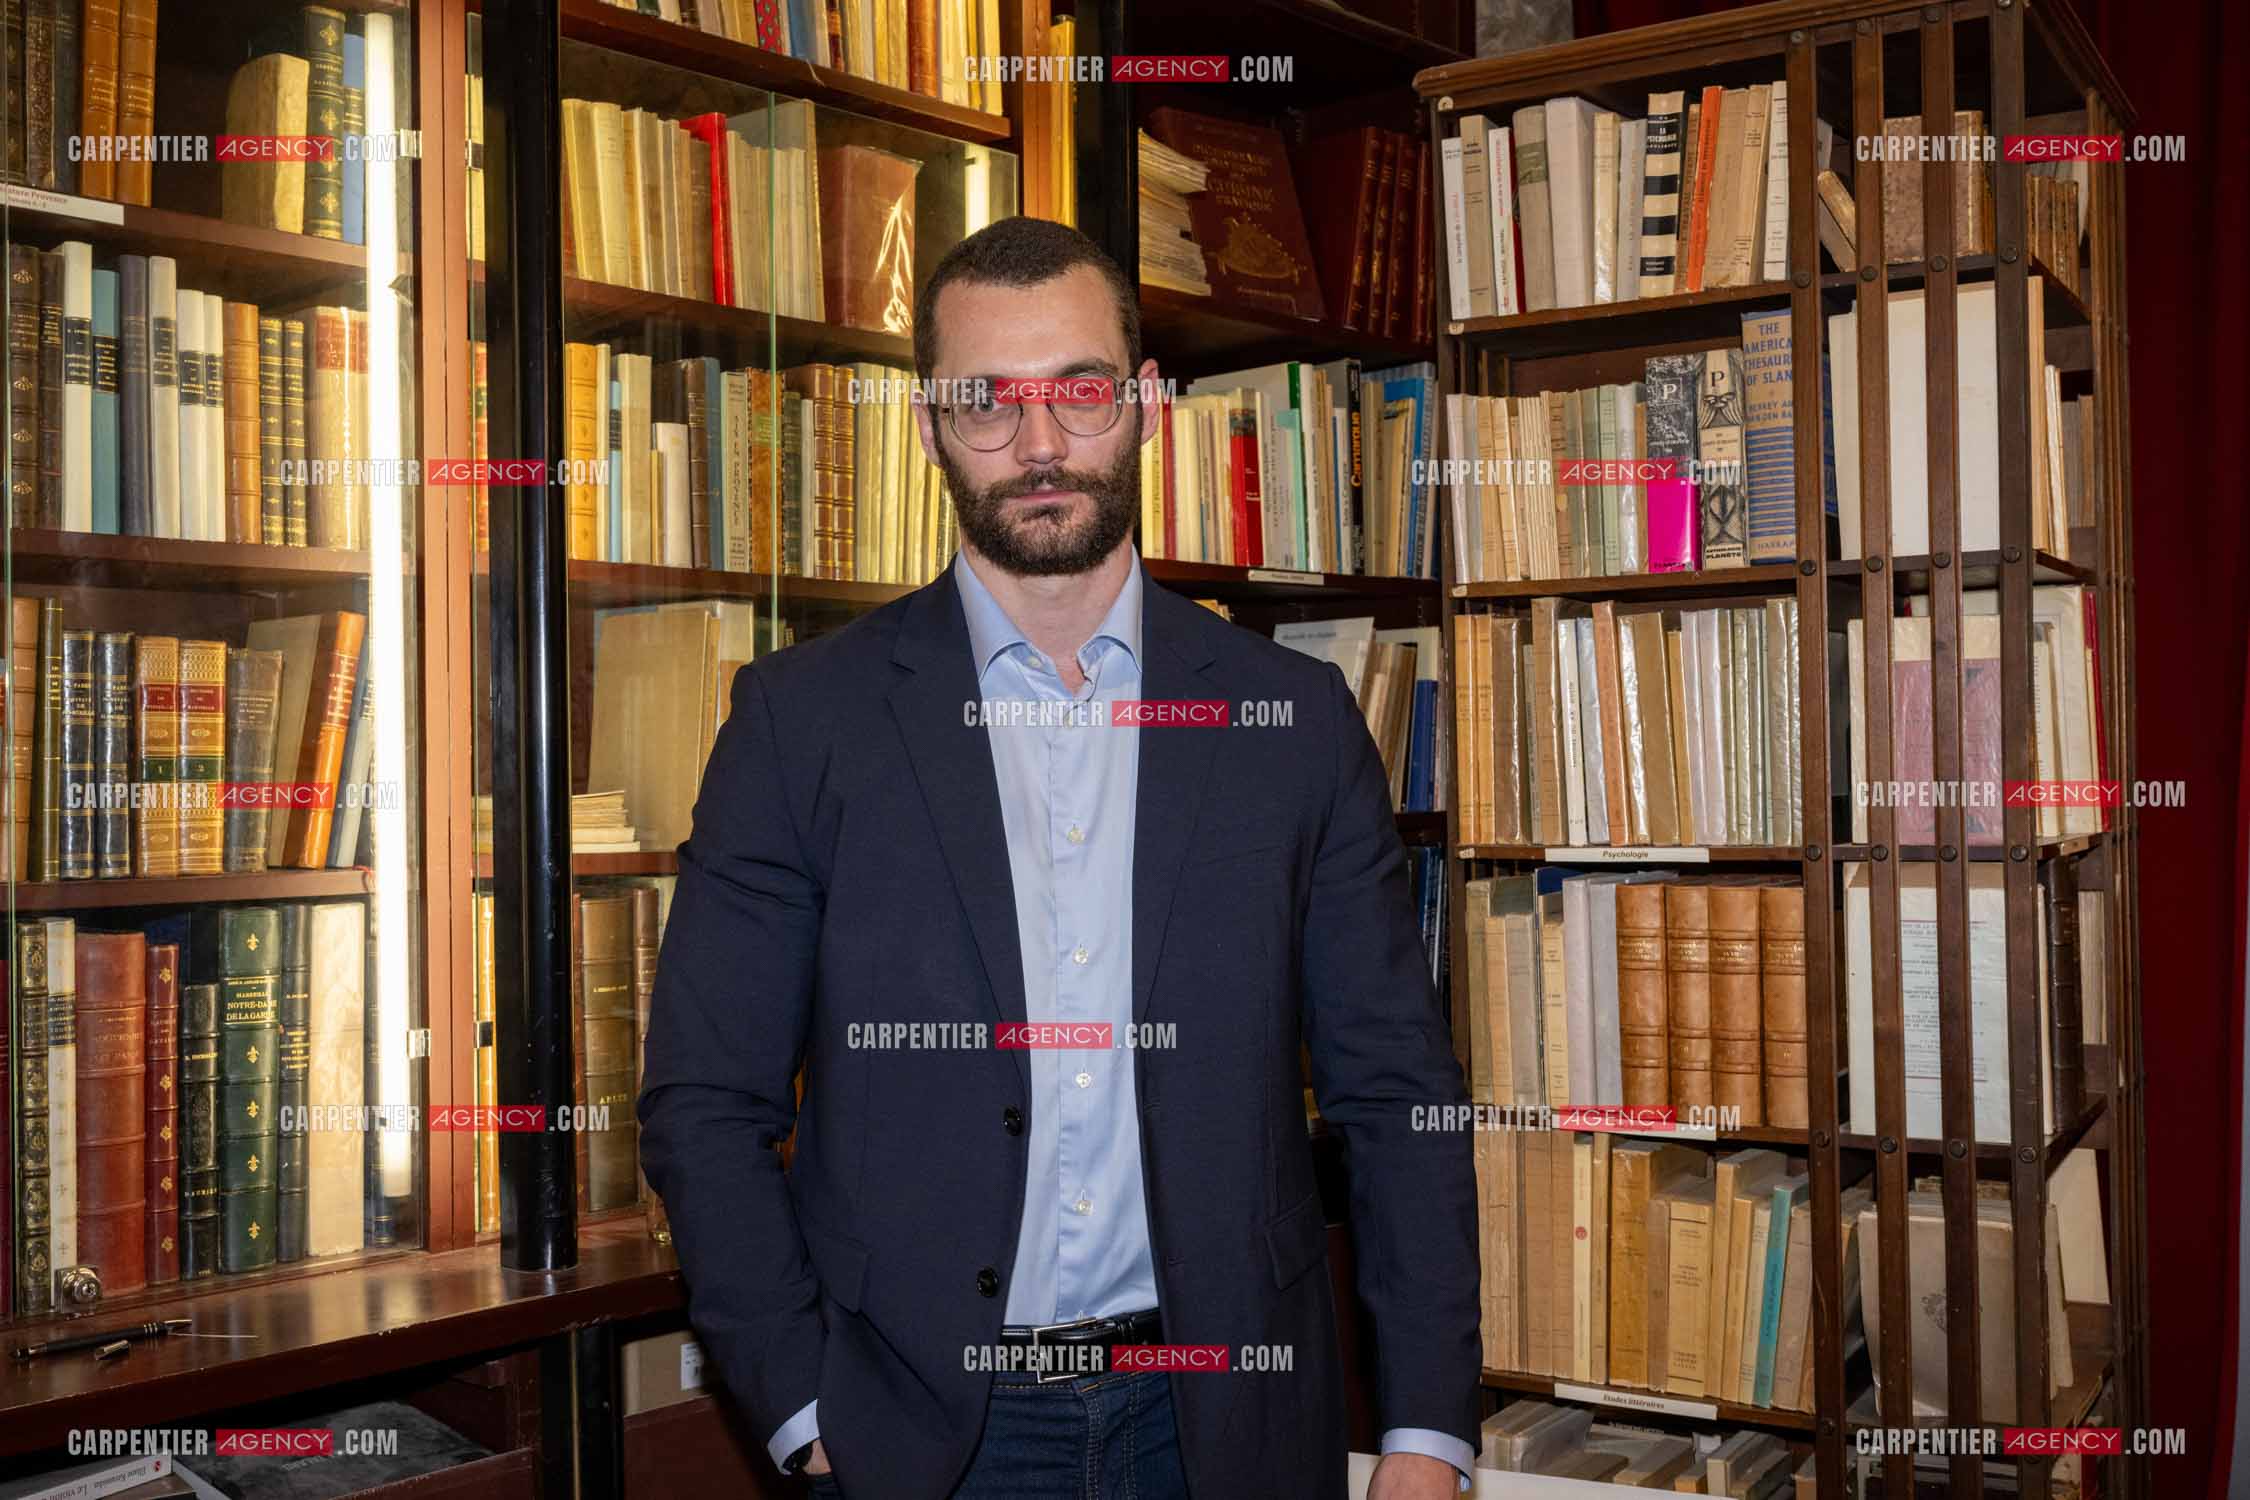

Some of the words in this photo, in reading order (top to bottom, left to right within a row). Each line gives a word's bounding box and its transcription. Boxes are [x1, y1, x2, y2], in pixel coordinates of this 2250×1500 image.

[1759, 322, 1781, 336] THE
[1744, 337, 1793, 353] AMERICA
[1744, 353, 1793, 369] THESAUR
[1711, 371, 1725, 387] P
[1747, 375, 1758, 385] OF
[1763, 371, 1793, 384] SLAN
[1663, 384, 1677, 399] P
[1351, 411, 1362, 487] Camargue
[1602, 850, 1648, 860] Psychologie
[226, 1012, 238, 1021] DE
[238, 1012, 250, 1020] LA
